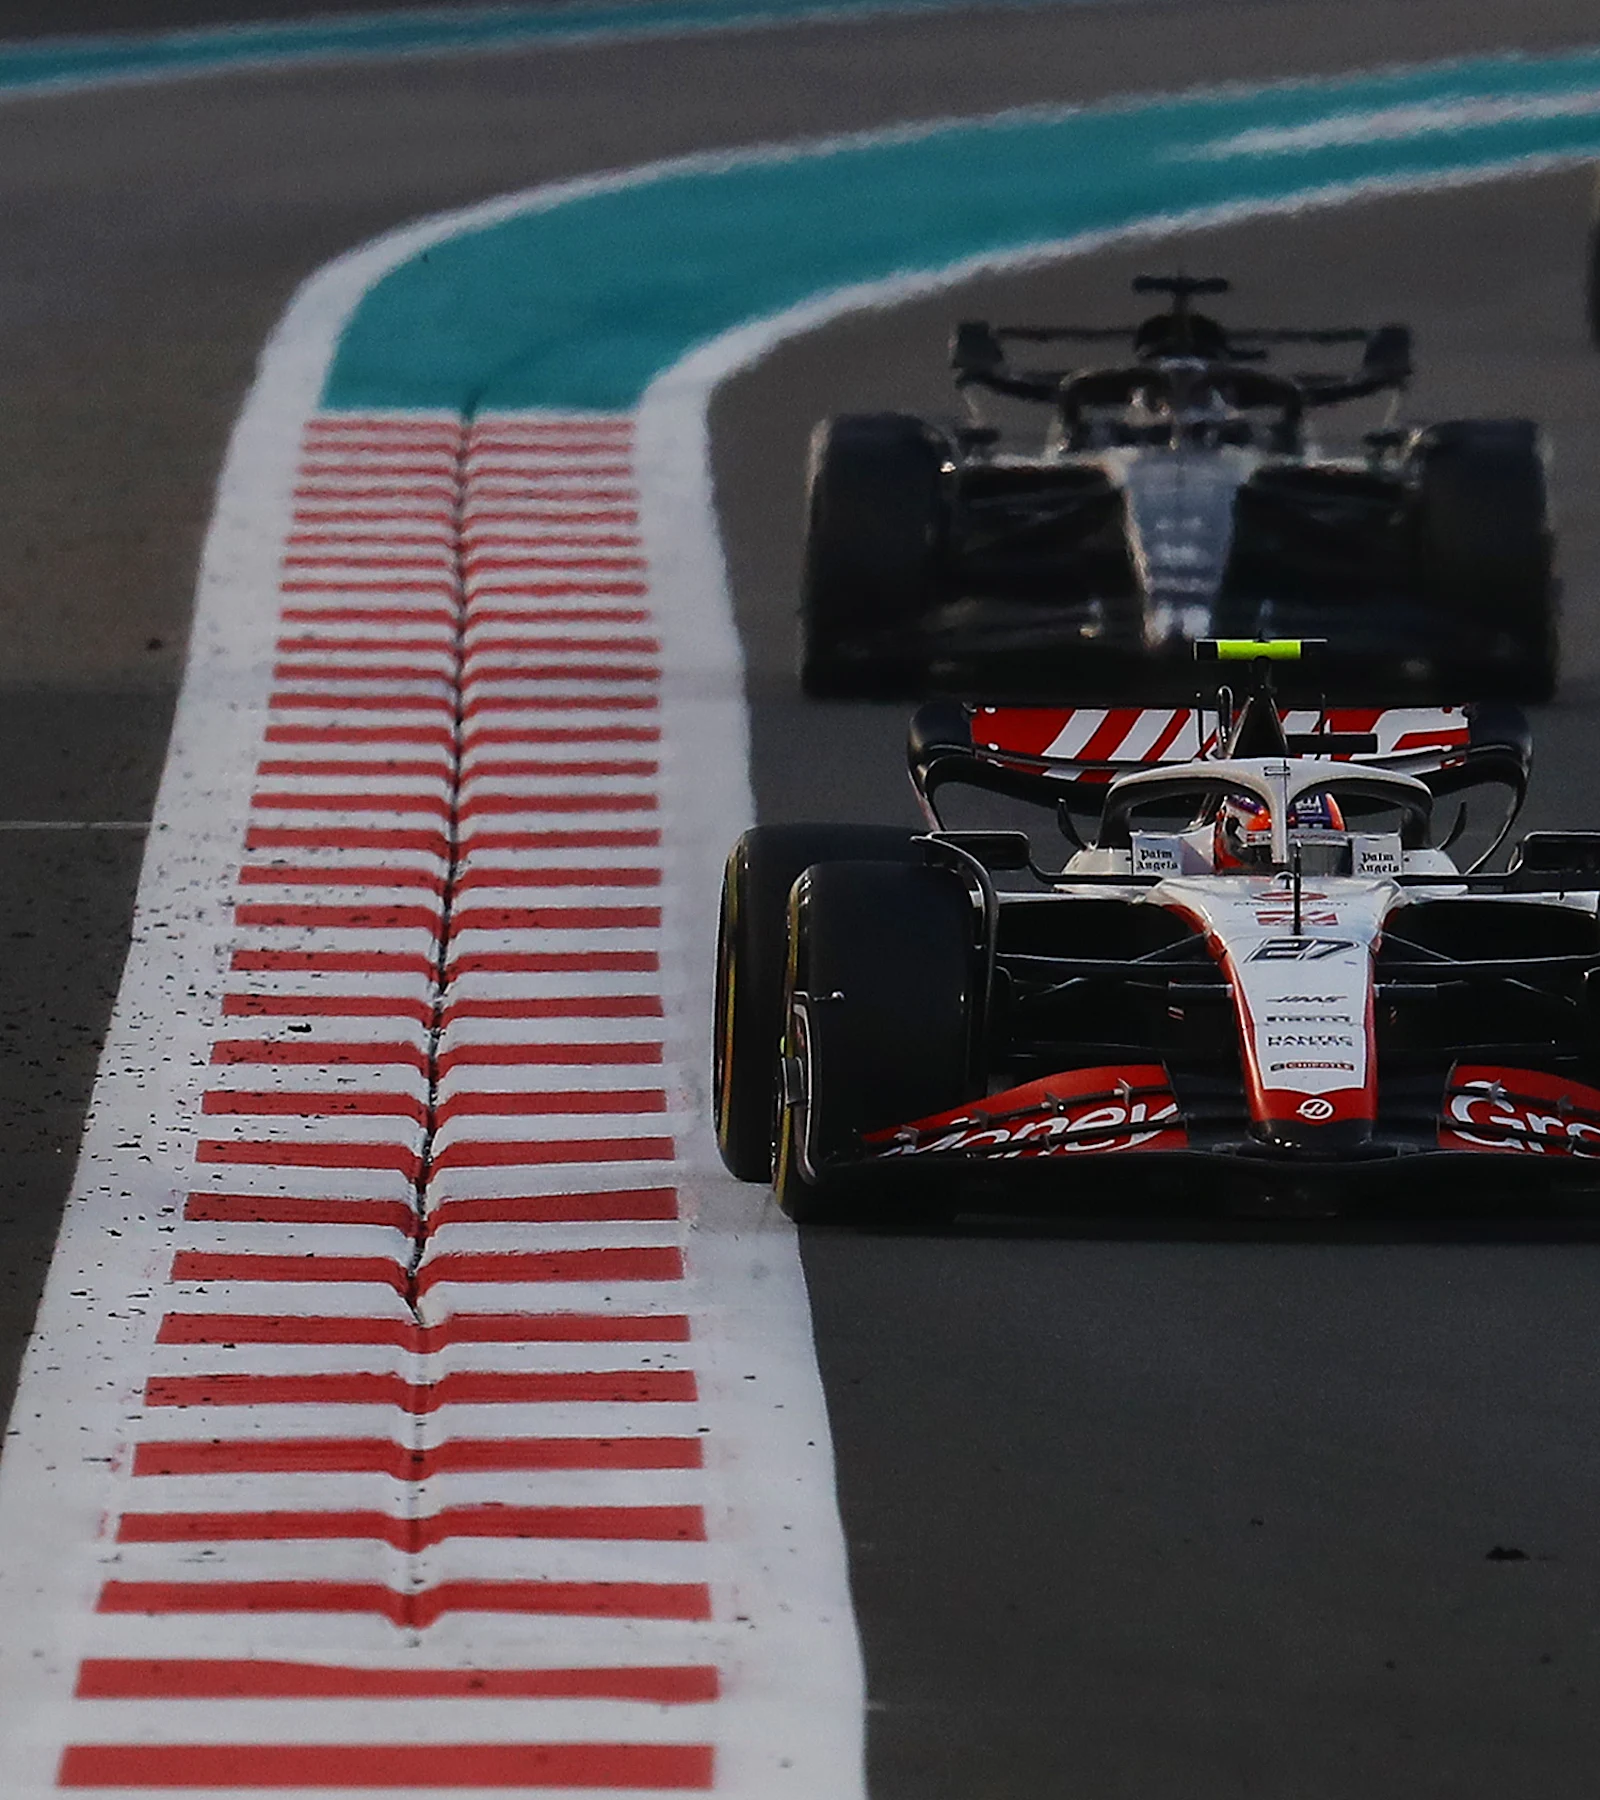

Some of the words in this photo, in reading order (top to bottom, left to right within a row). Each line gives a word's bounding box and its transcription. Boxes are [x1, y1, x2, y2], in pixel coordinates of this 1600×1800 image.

[1140, 849, 1172, 860] Palm
[1362, 852, 1394, 863] Palm
[1136, 861, 1178, 871] Angels
[1358, 863, 1400, 874] Angels
[1242, 937, 1360, 963] 27
